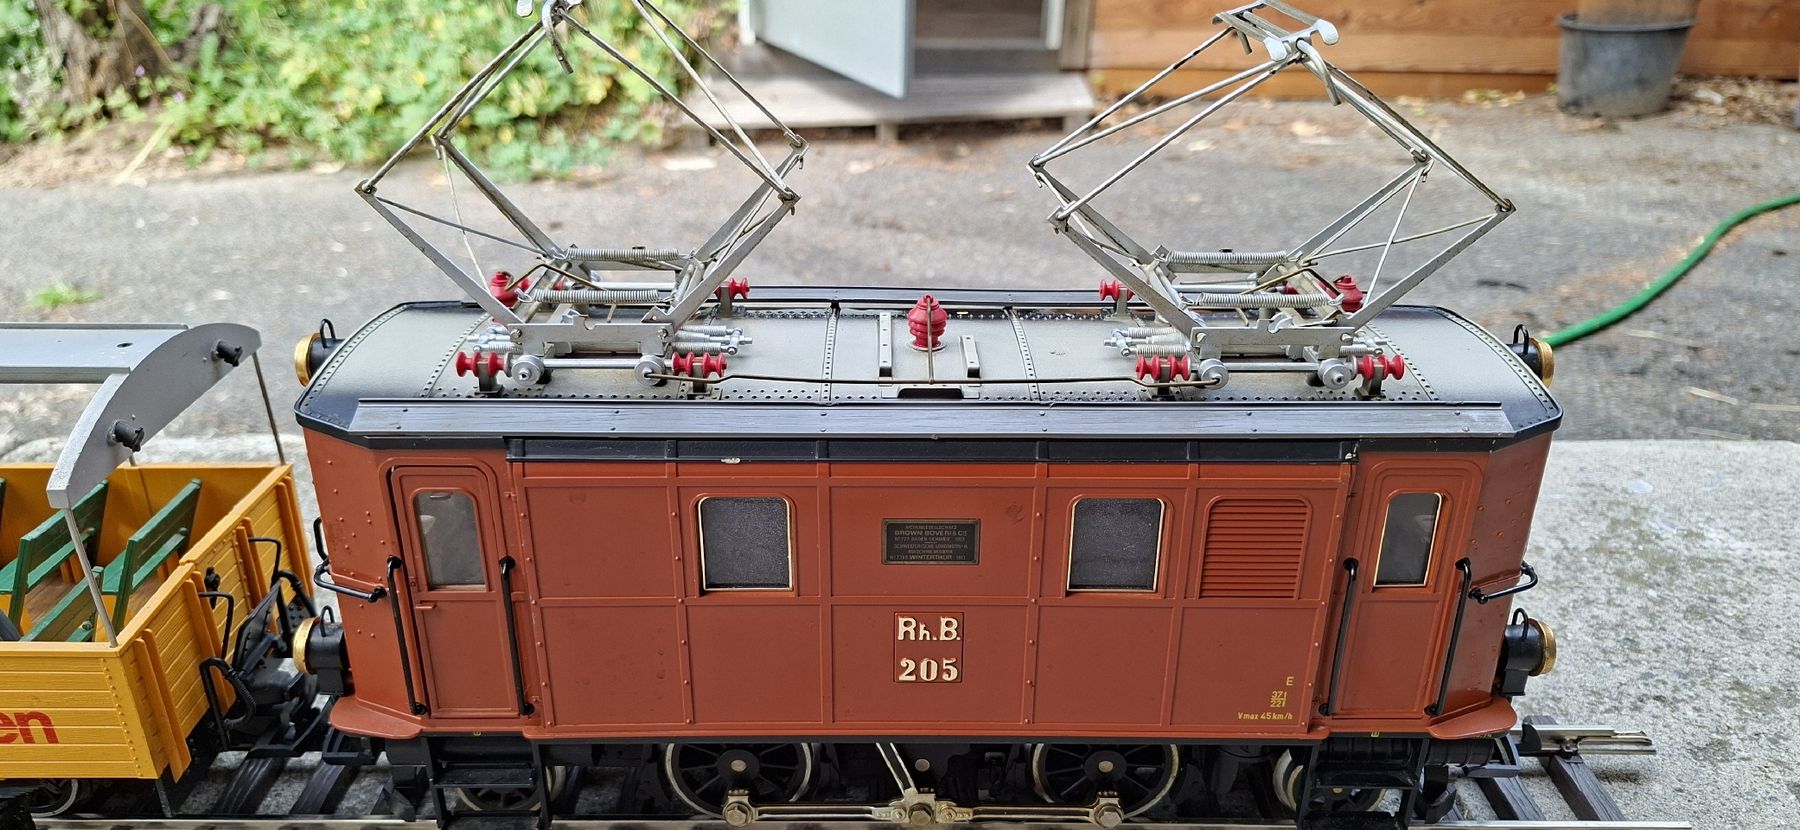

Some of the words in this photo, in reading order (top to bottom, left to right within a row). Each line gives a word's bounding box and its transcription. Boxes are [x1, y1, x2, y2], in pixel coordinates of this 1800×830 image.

[898, 657, 958, 681] 205
[1286, 676, 1294, 686] E
[1238, 712, 1259, 720] Vmax
[1260, 712, 1272, 720] 45
[1272, 712, 1293, 720] km/h
[0, 711, 60, 744] en
